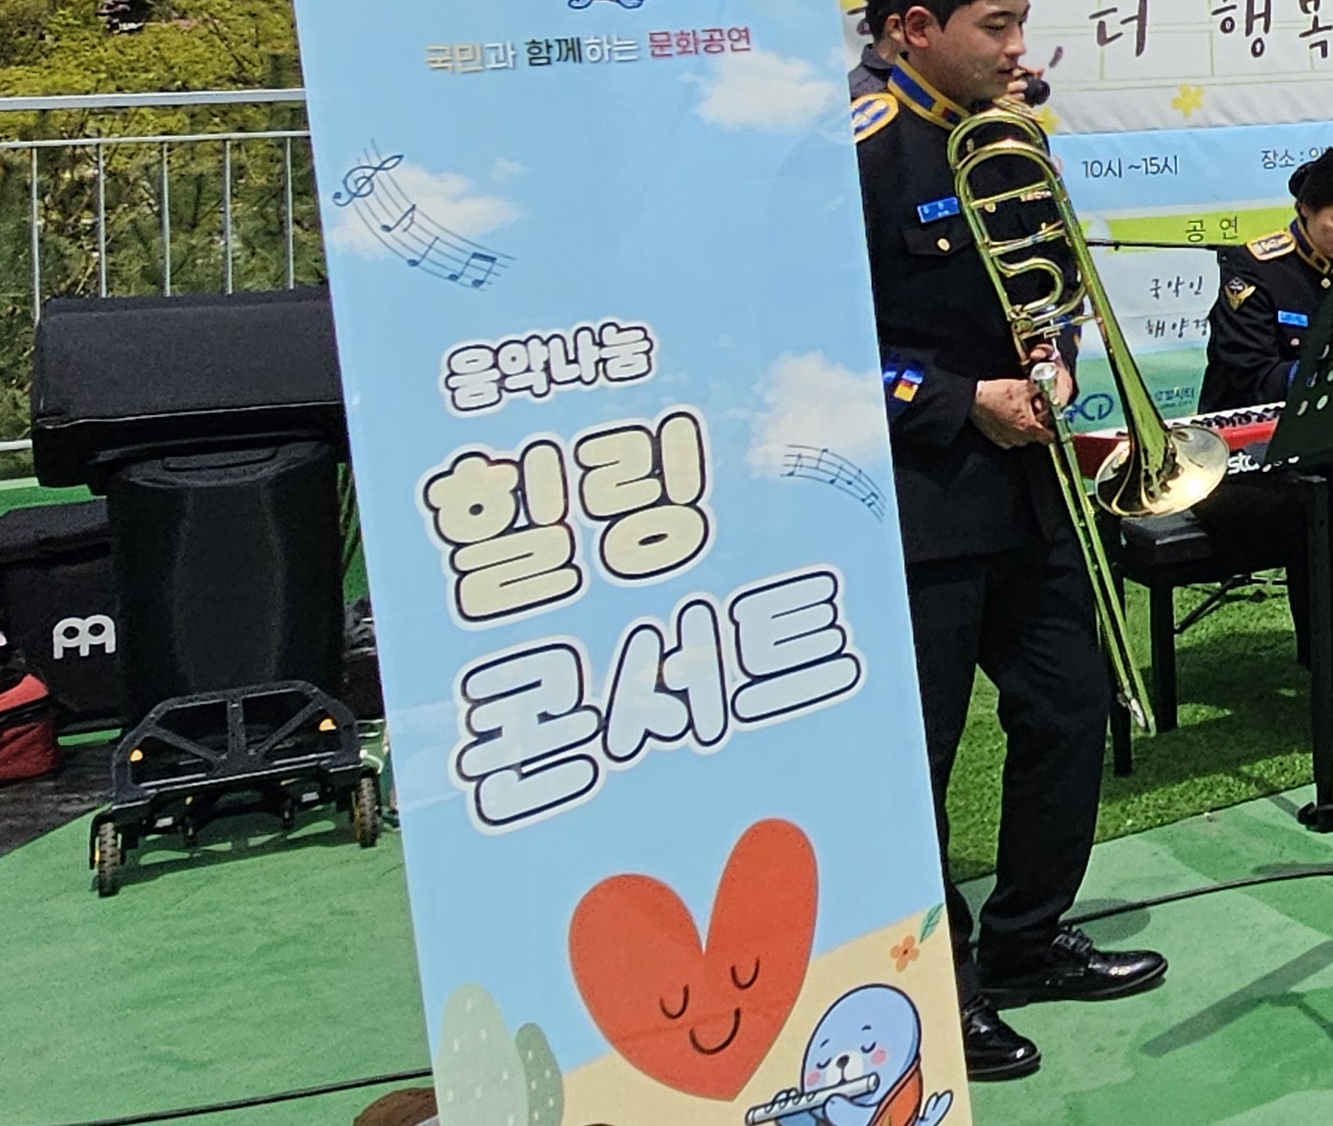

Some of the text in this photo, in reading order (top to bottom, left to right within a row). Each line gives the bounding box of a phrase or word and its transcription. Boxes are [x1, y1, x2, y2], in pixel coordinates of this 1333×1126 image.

[423, 25, 753, 75] 국민과 함께하는 문화공연
[1082, 157, 1123, 180] 10시
[1260, 148, 1296, 171] 장소
[446, 321, 656, 412] 음악나눔
[423, 409, 711, 623] 힐링
[456, 571, 864, 828] 콘서트
